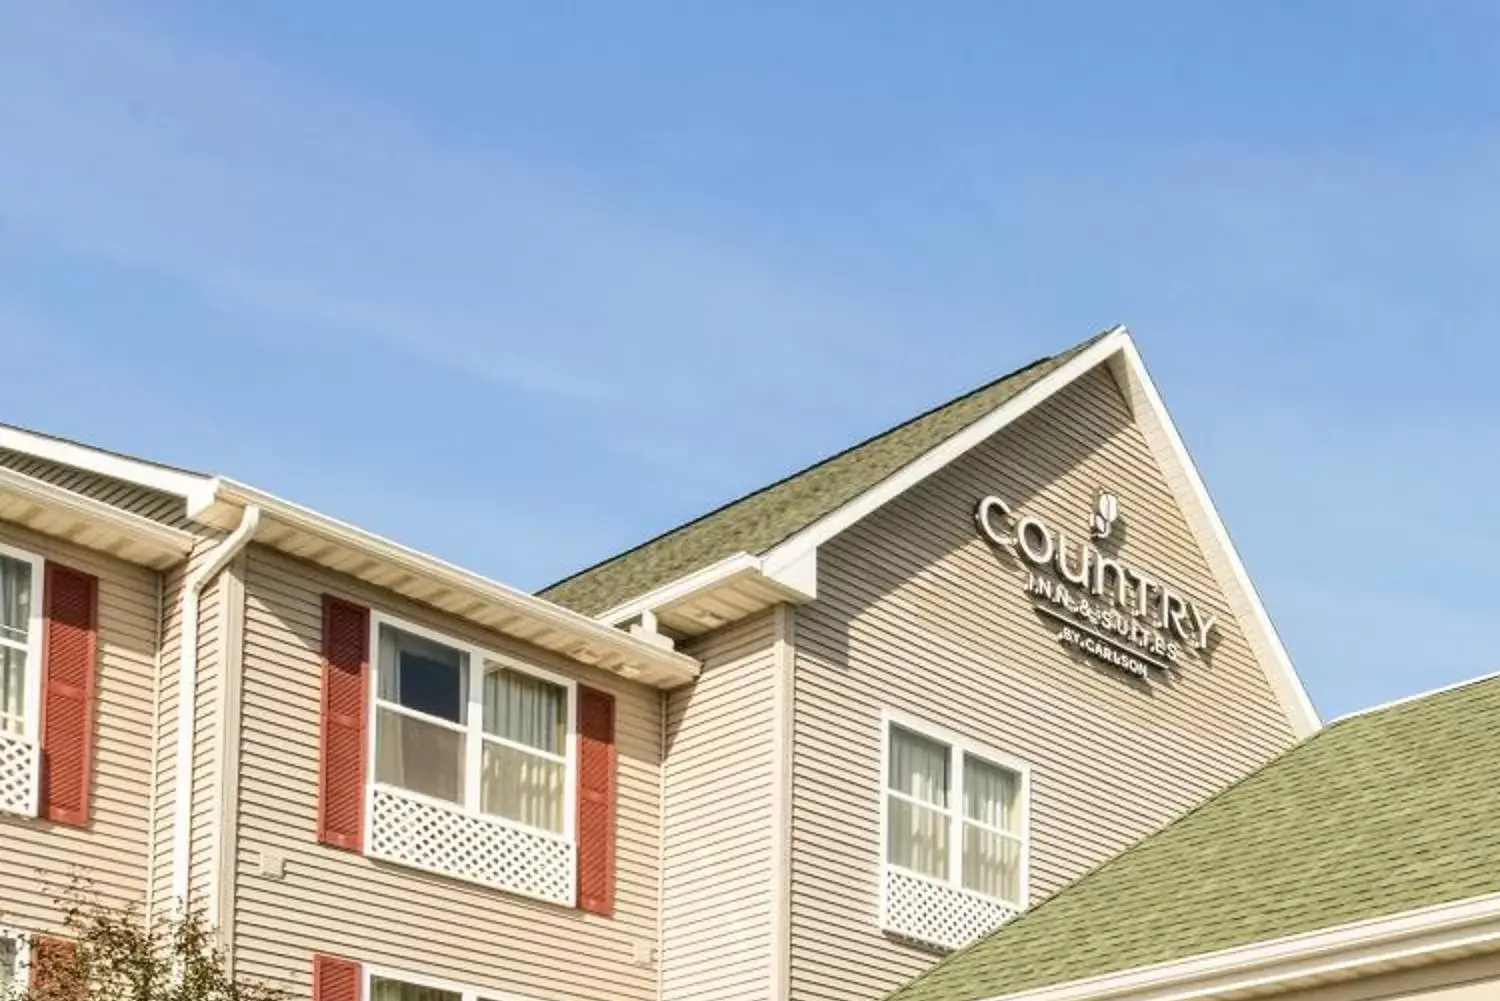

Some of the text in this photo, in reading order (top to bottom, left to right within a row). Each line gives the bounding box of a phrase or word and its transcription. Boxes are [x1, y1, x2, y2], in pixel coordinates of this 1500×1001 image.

[1026, 571, 1071, 611] INN
[1100, 610, 1178, 661] SUITES
[1060, 626, 1148, 678] BY CARLSON
